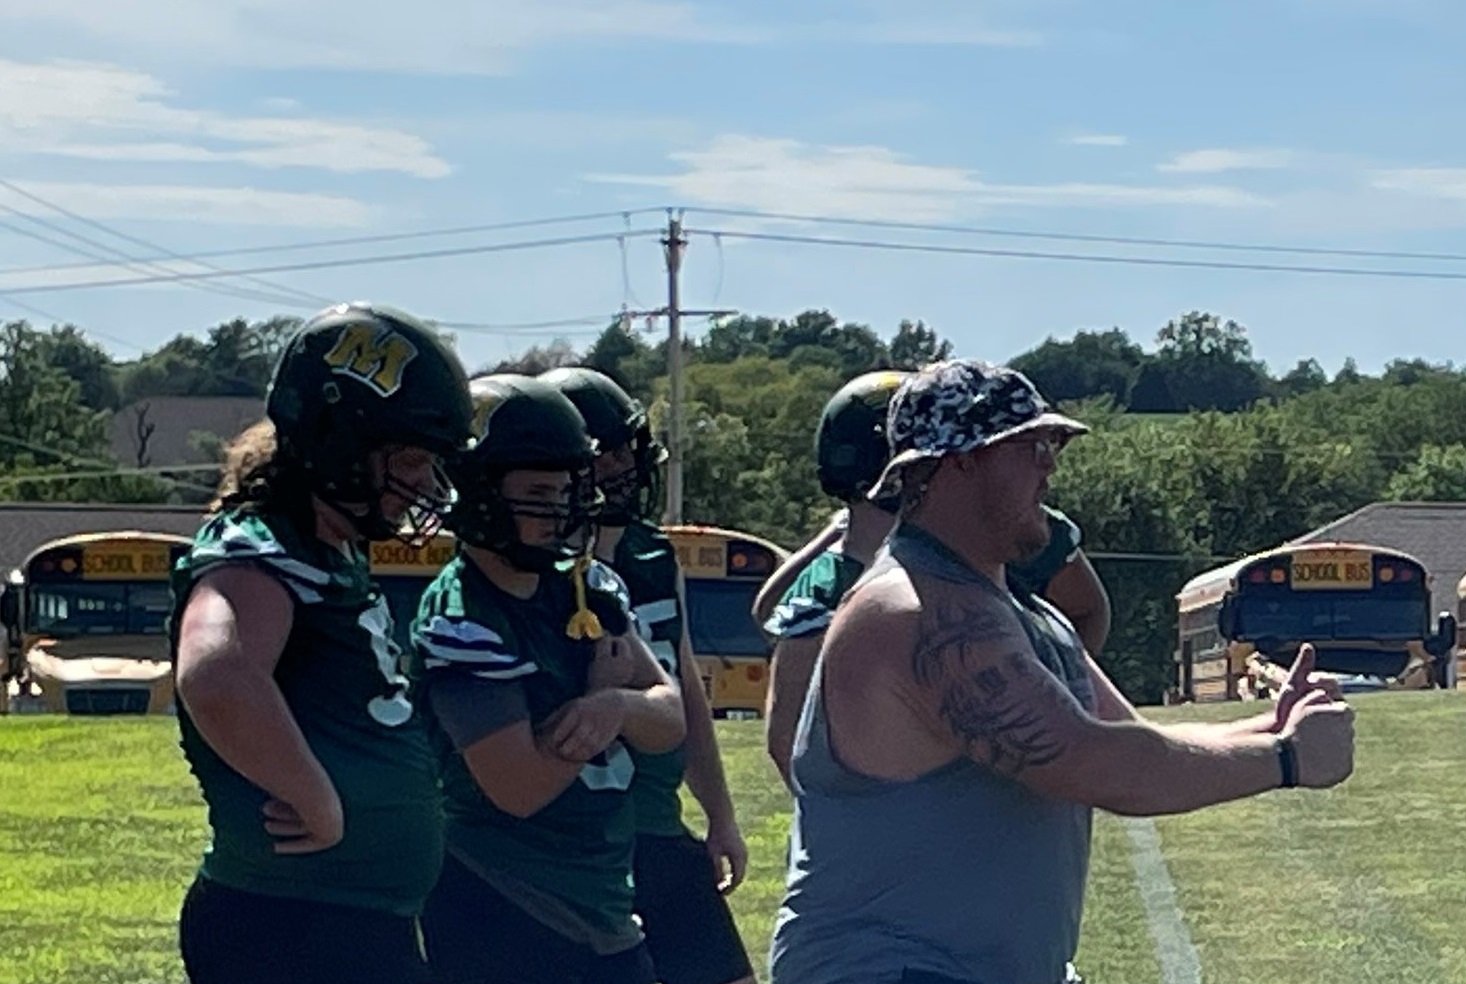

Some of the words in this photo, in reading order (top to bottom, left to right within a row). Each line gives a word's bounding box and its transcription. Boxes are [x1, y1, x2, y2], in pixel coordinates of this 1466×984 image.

[323, 322, 418, 398] M
[84, 554, 136, 573] SCHOOL
[141, 554, 169, 573] BUS
[373, 544, 425, 565] SCHOOL
[1294, 563, 1340, 580] SCHOOL
[1345, 563, 1369, 581] BUS
